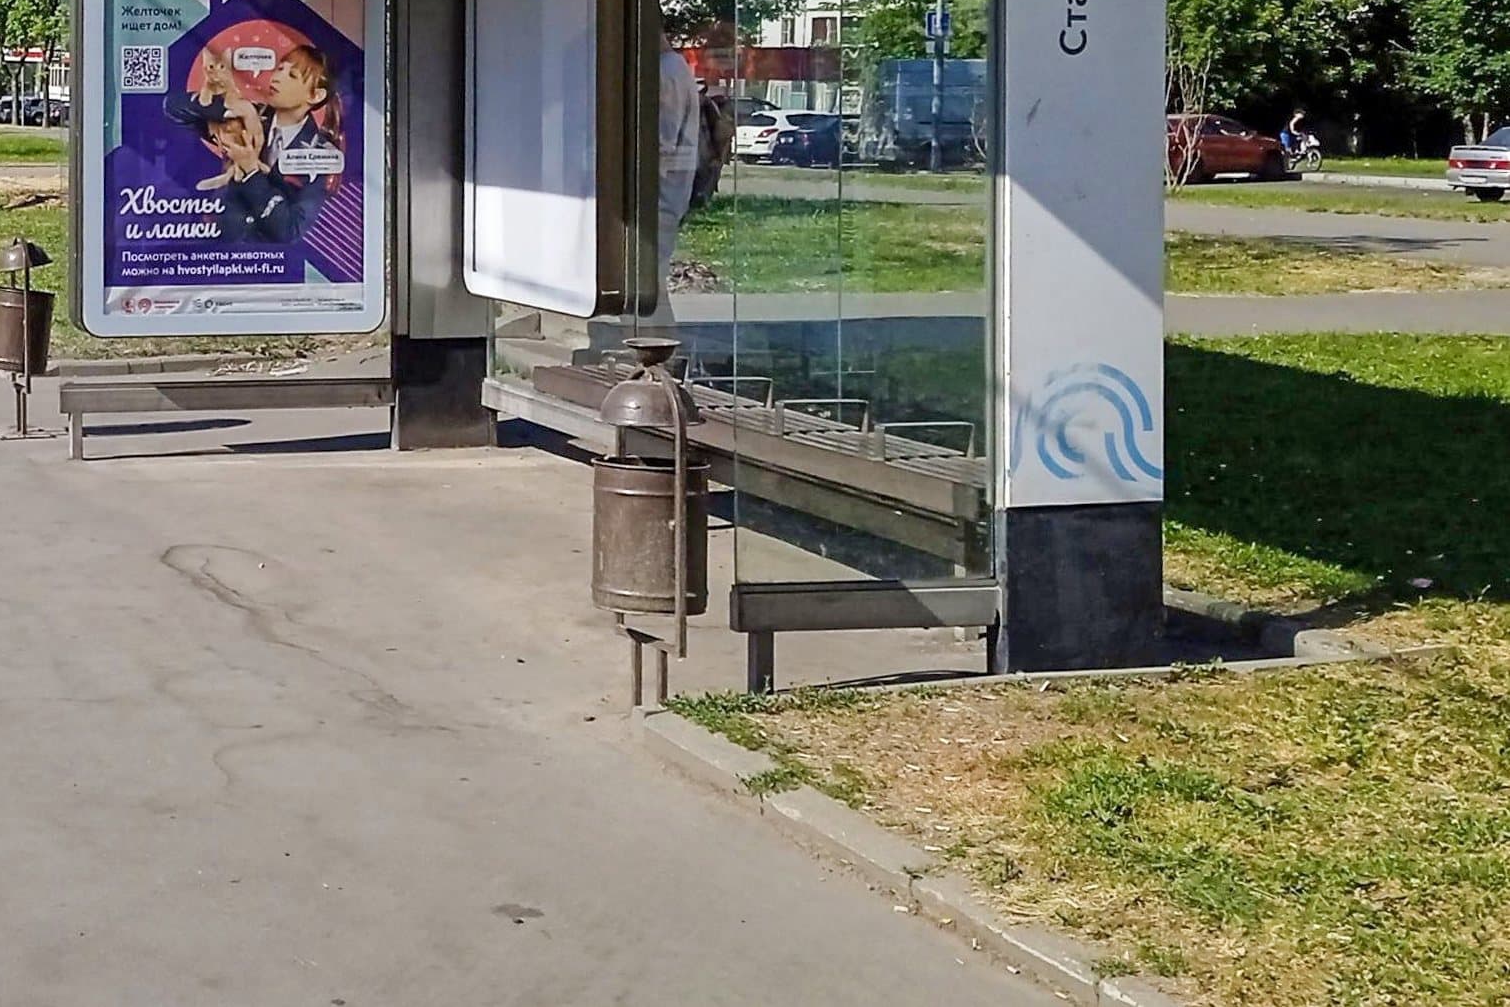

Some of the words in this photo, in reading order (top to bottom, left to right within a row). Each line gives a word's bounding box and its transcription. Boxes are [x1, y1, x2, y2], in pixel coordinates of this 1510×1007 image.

[121, 6, 180, 18] Желточек
[121, 22, 152, 32] ищет
[154, 20, 182, 33] дом!
[119, 187, 226, 216] Хвосты
[126, 224, 142, 240] и
[146, 220, 221, 240] лапки
[122, 251, 188, 263] Посмотреть
[190, 252, 228, 261] анкеты
[230, 251, 284, 260] животных
[122, 267, 160, 277] можно
[162, 267, 174, 276] на
